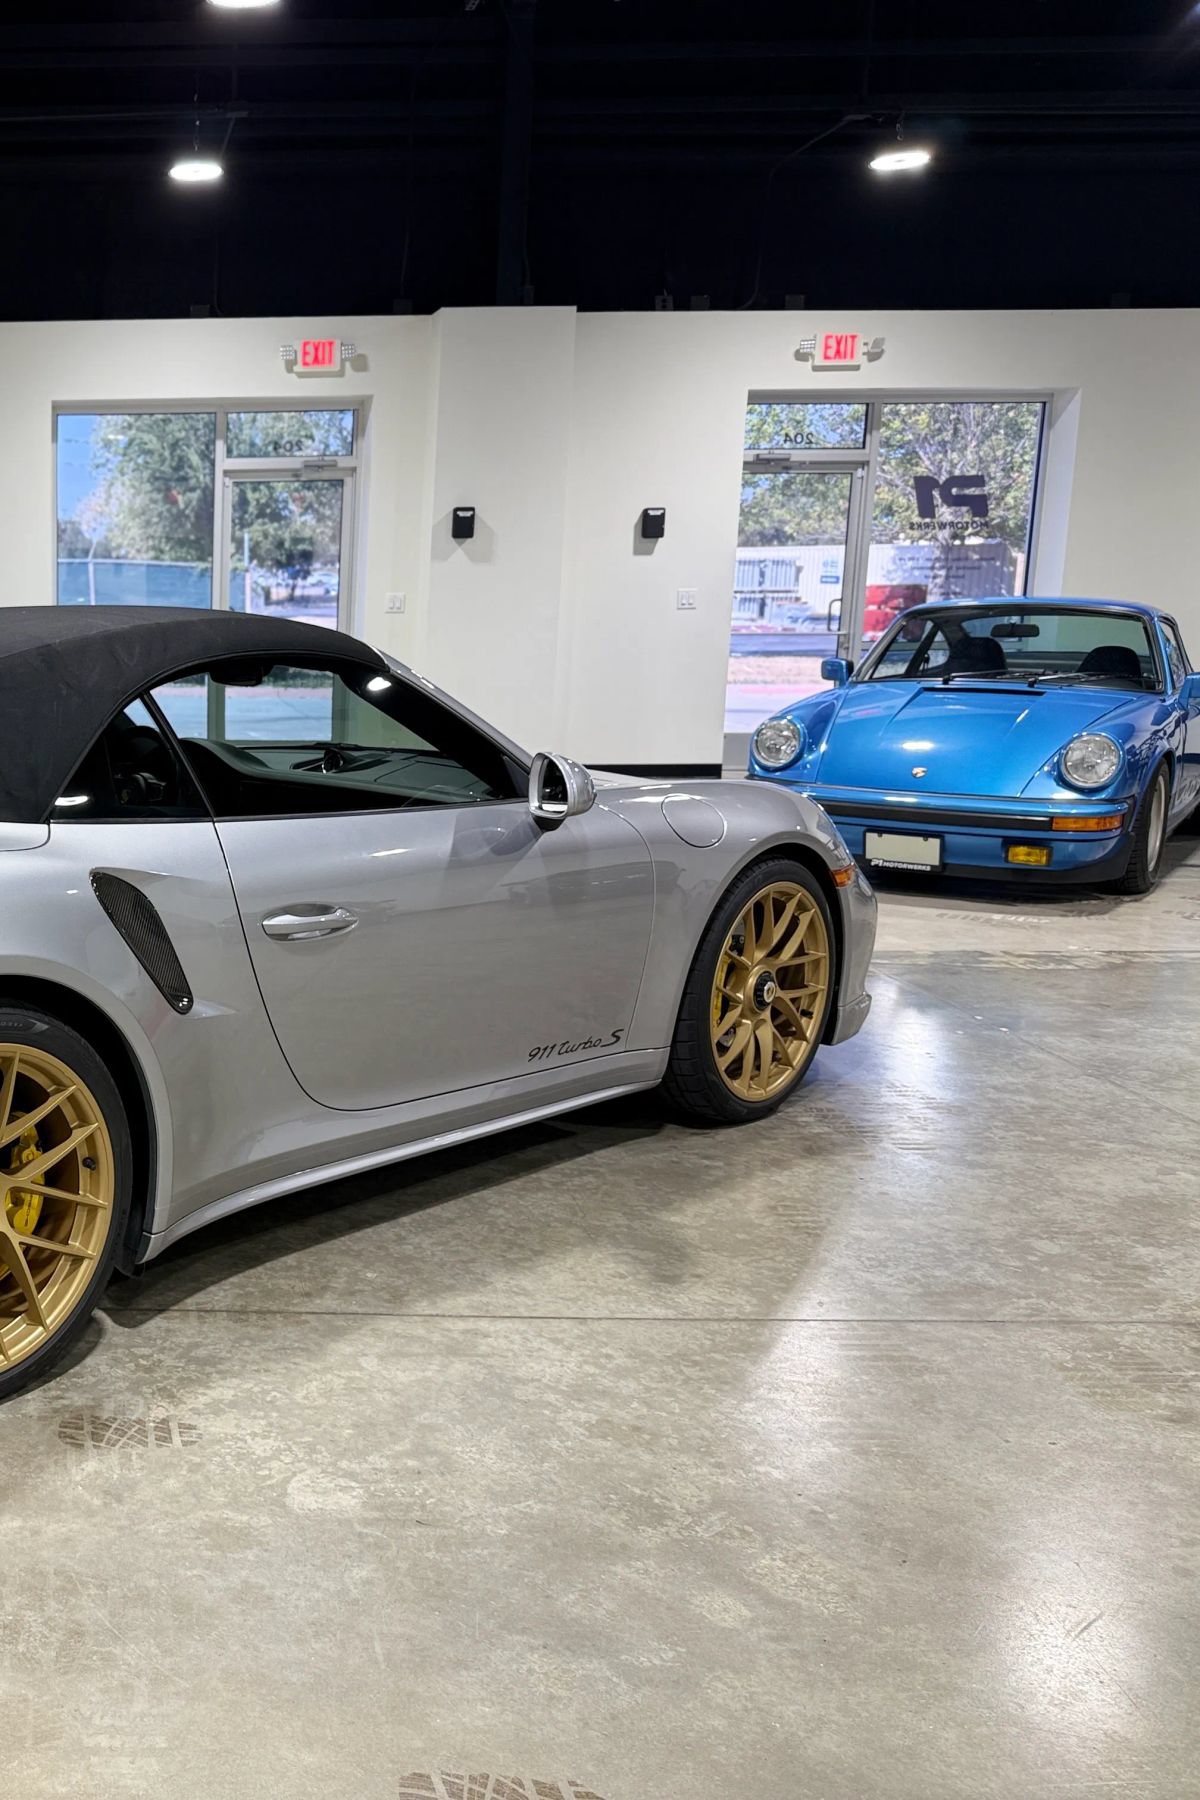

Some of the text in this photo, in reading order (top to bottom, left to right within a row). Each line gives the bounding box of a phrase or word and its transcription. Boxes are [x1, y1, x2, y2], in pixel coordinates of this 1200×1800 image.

[301, 339, 336, 368] EXIT
[823, 334, 858, 361] EXIT
[883, 861, 931, 871] MOTORWERKS
[527, 1043, 557, 1063] 911
[600, 1028, 625, 1048] S
